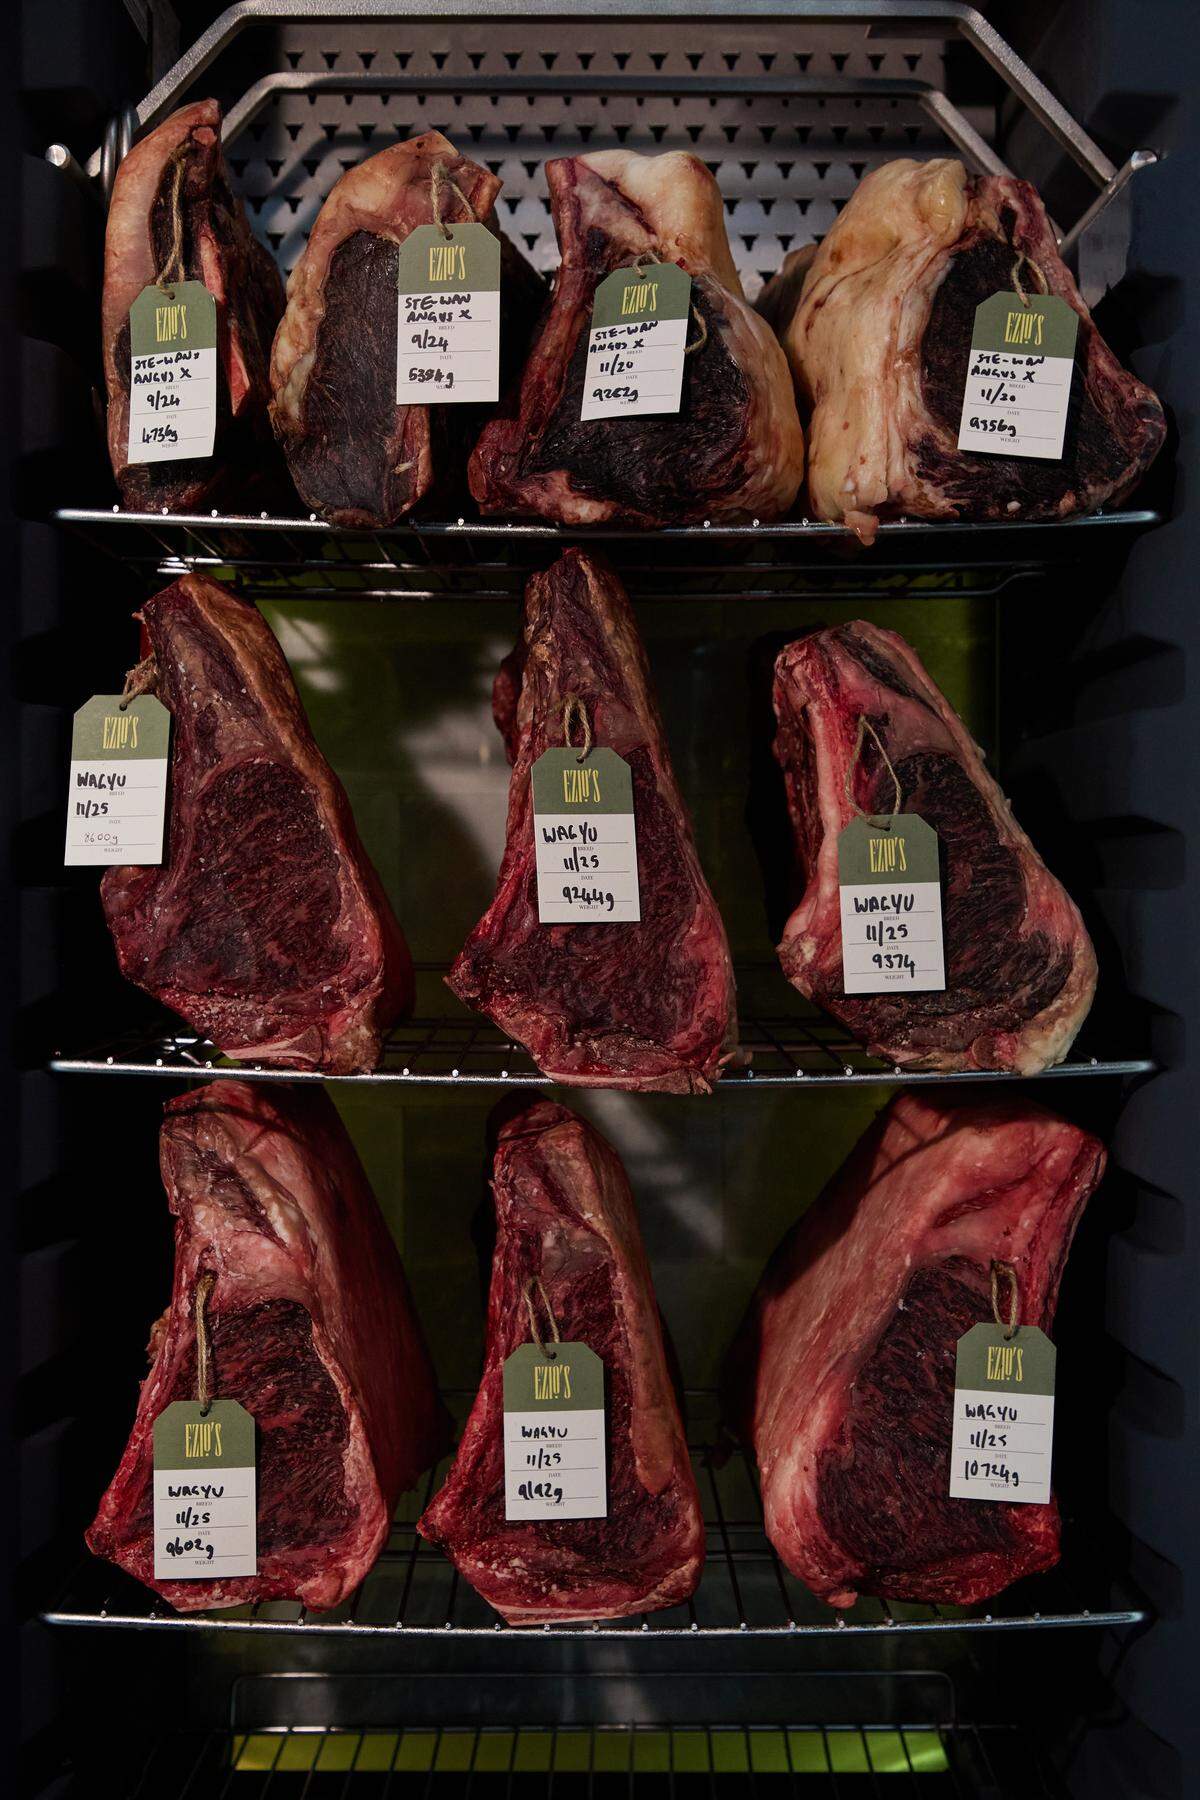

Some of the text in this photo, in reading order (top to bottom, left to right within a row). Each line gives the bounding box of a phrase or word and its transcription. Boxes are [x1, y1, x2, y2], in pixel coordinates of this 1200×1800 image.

[429, 245, 465, 281] EZIO'S
[405, 294, 471, 310] STE-WAN
[622, 283, 658, 315] EZIO'S
[156, 305, 187, 342] EZIO'S
[407, 312, 453, 323] ANGUS
[595, 321, 658, 340] STE-WAN
[1005, 312, 1044, 345] EZIO'S
[411, 330, 448, 352] 9/24
[590, 343, 627, 353] ANGUS
[134, 351, 192, 370] STE-WAN
[600, 354, 633, 375] 11/20
[977, 354, 1045, 366] STE-WAN
[134, 371, 174, 384] ANGUS
[971, 366, 1016, 379] ANGUS
[147, 391, 180, 410] 9/24
[981, 383, 1016, 404] 11/20
[103, 716, 138, 749] EZIO'S
[77, 772, 126, 790] WAGYU
[563, 769, 600, 802] EZIO'S
[76, 800, 109, 818] 11/25
[542, 822, 598, 844] WAGYU
[564, 847, 599, 872] 11/25
[870, 837, 907, 872] EZIO'S
[562, 886, 614, 911] 9244g
[854, 894, 914, 914] WAGYU
[866, 921, 908, 946] 11/25
[872, 954, 915, 978] 9374
[987, 1346, 1023, 1382] EZIO'S
[534, 1365, 571, 1400] EZIO'S
[966, 1404, 1017, 1421] WAGYU
[185, 1422, 222, 1458] EZIO'S
[521, 1426, 568, 1438] WAGYU
[970, 1429, 1007, 1448] 11/25
[527, 1448, 561, 1469] 11/25
[965, 1461, 1019, 1486] 10724g
[168, 1485, 224, 1498] WAGYU
[176, 1507, 210, 1528] 11/25
[166, 1537, 214, 1559] 9602g
